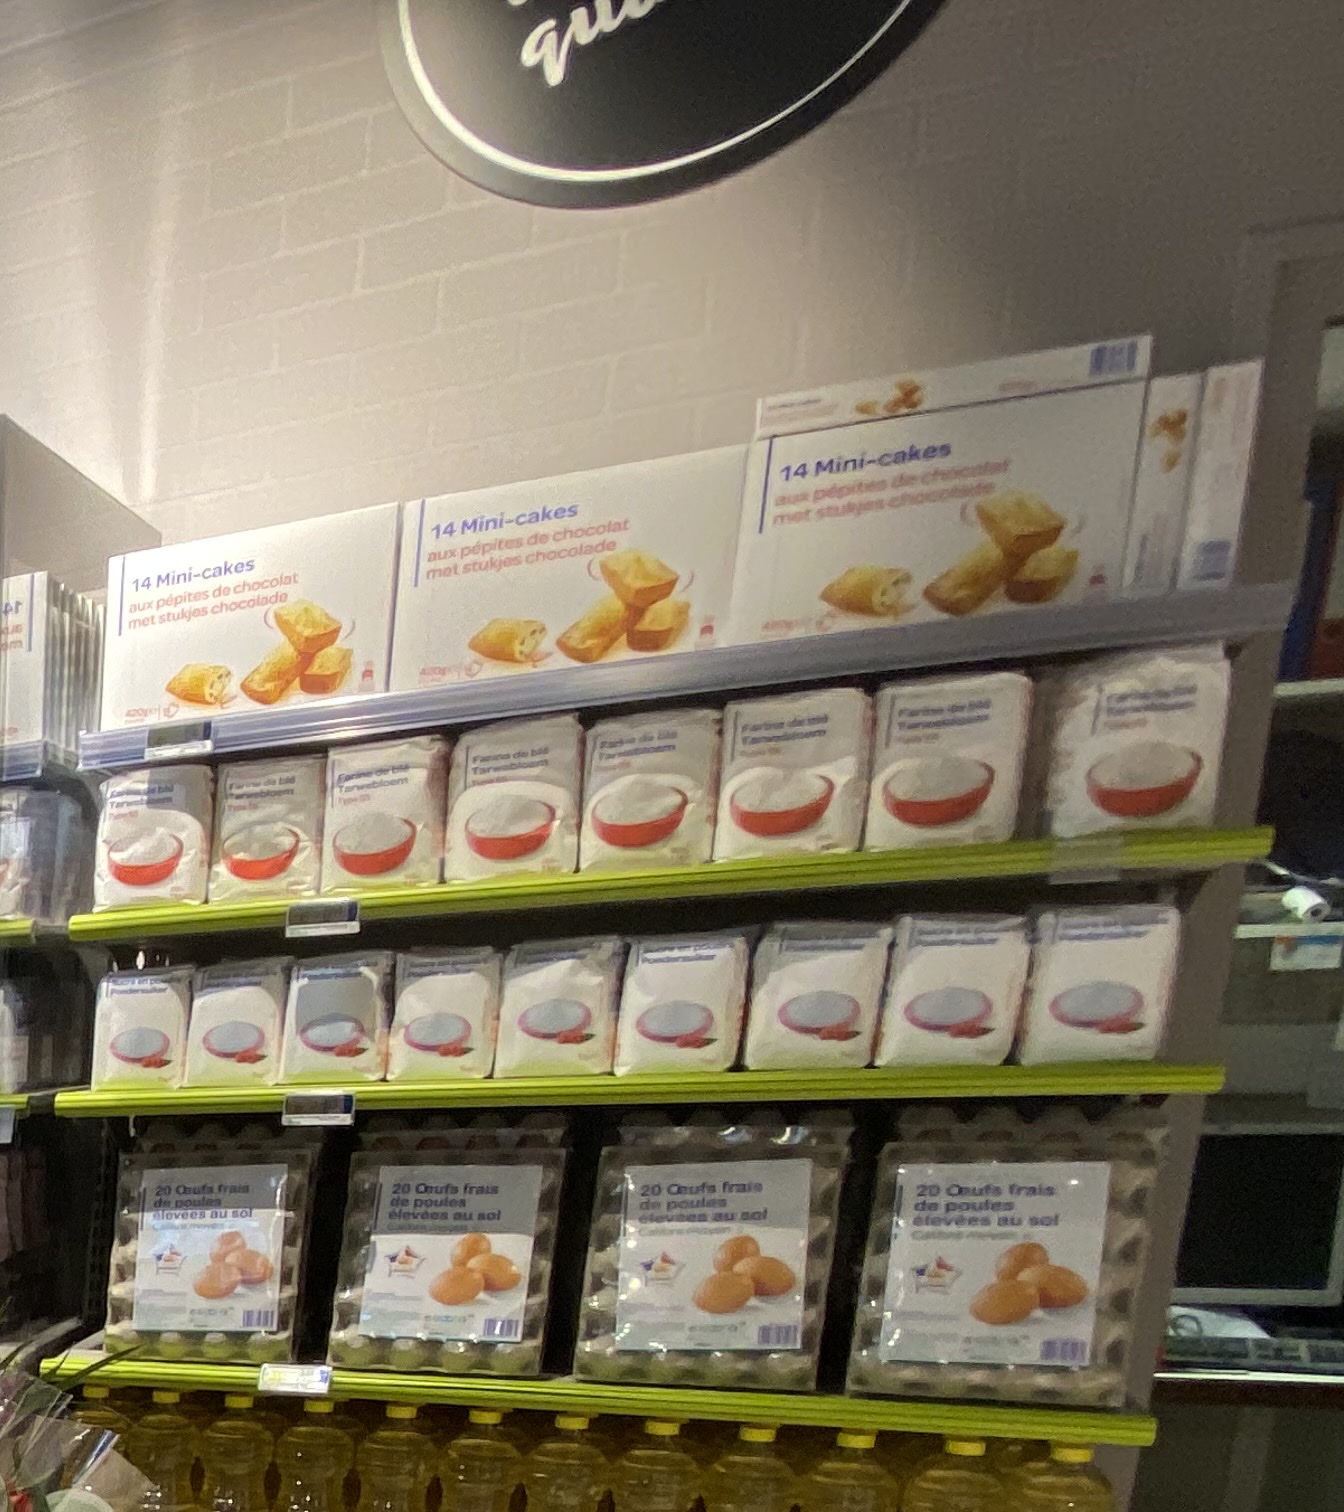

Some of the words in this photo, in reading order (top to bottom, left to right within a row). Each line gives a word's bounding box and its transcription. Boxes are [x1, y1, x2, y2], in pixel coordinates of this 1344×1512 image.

[781, 463, 809, 482] 14
[815, 442, 952, 477] Mini-cakes
[431, 522, 457, 539] 14
[461, 503, 579, 536] Mini-cakes
[426, 549, 457, 563] aux
[459, 536, 523, 562] pépites
[527, 531, 550, 546] de
[552, 518, 631, 542] chocolat
[132, 577, 152, 592] 14
[156, 558, 256, 588] Mini-cakes
[425, 564, 459, 580] met
[462, 552, 522, 578] stukjes
[525, 538, 617, 565] chocolade
[128, 599, 154, 614] aux
[156, 588, 209, 613] pépites
[212, 582, 231, 597] de
[233, 572, 300, 594] chocolat
[128, 615, 157, 630] met
[158, 602, 209, 625] stukjes
[210, 591, 289, 615] chocolade
[390, 1196, 409, 1207] de
[413, 1197, 466, 1208] poules
[392, 1183, 410, 1194] 20
[464, 1182, 499, 1195] frais
[916, 1183, 941, 1197] 20
[1009, 1183, 1056, 1196] frais
[453, 1211, 472, 1221] au
[477, 1209, 501, 1220] sol
[914, 1199, 939, 1211] de
[945, 1199, 1015, 1213] poules
[997, 1216, 1022, 1226] au
[1029, 1213, 1060, 1226] sol
